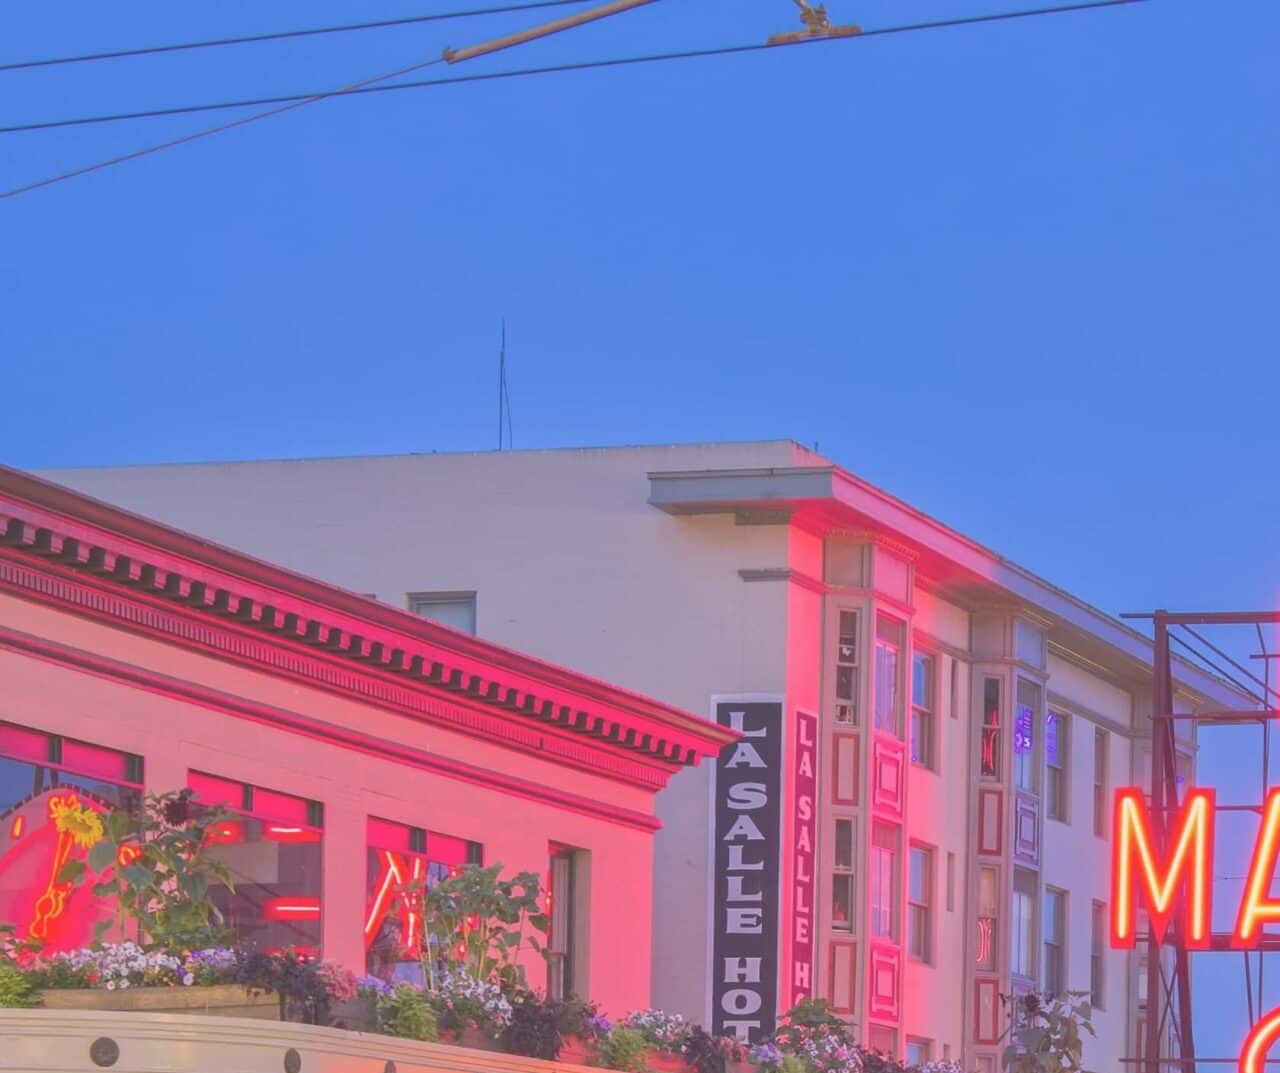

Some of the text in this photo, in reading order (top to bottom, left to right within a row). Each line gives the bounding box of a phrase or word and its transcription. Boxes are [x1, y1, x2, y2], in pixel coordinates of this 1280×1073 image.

[724, 712, 768, 768] LA
[723, 782, 768, 935] SALLE
[796, 796, 812, 943] SALLE
